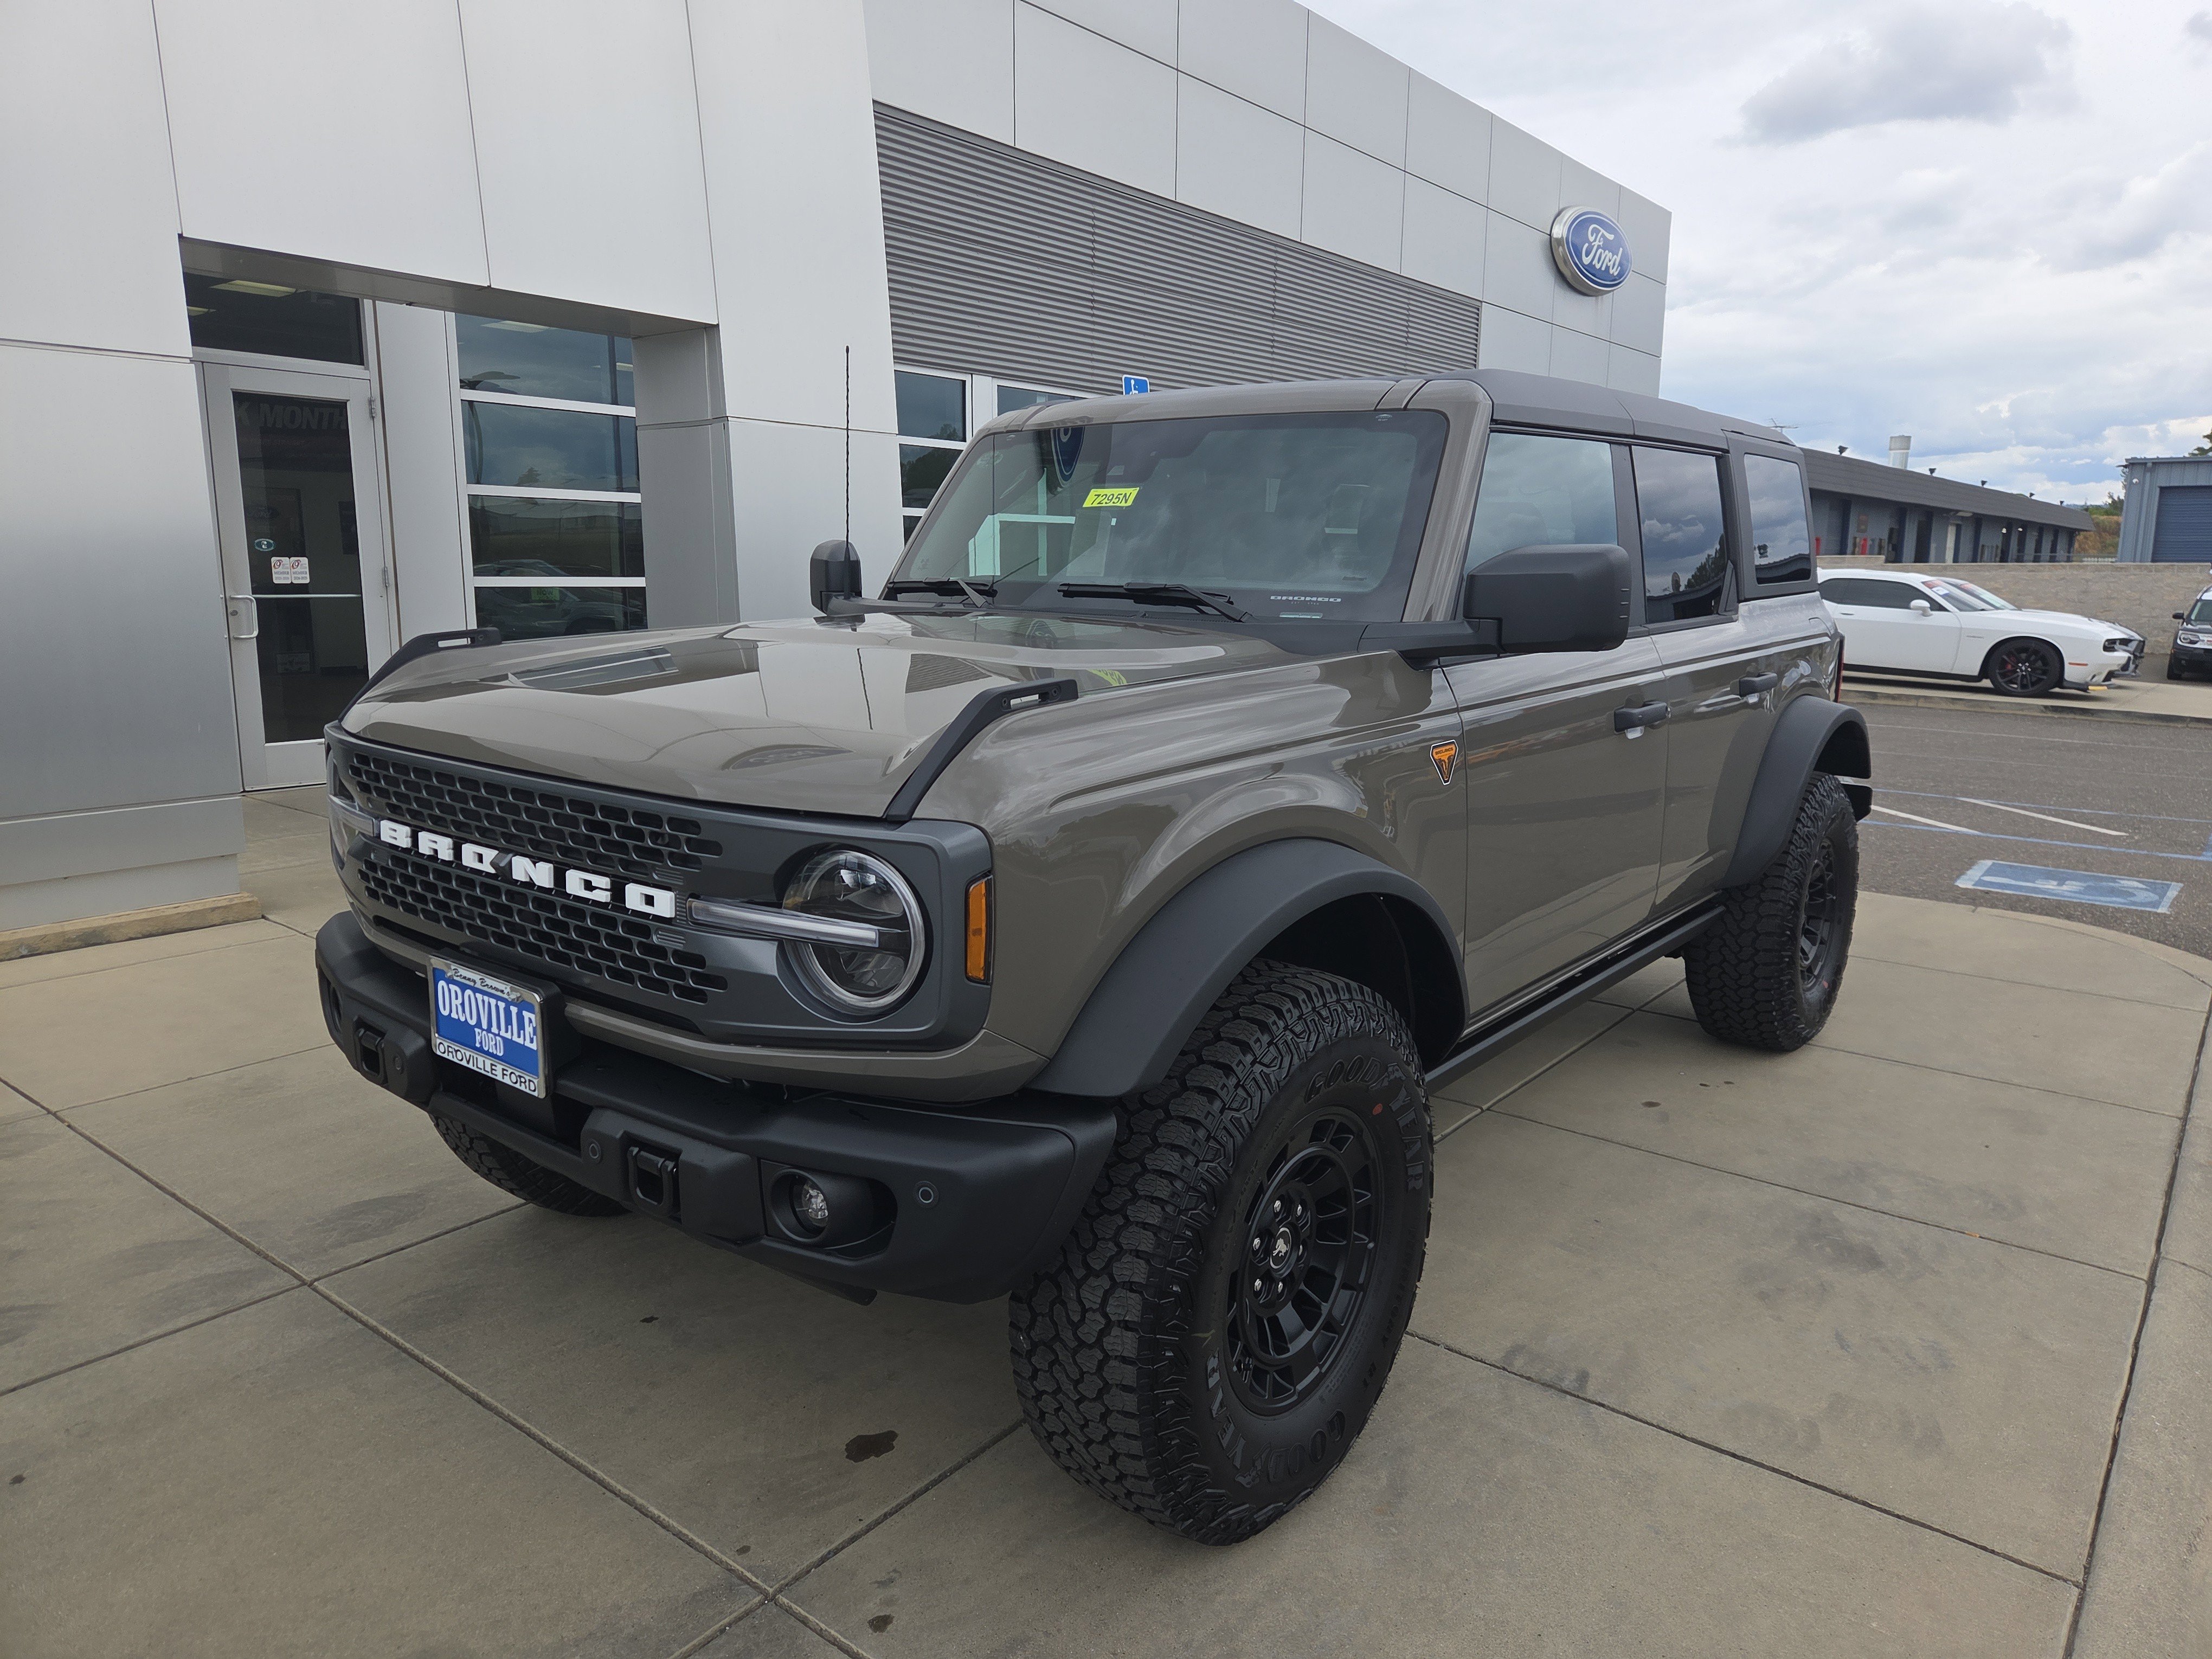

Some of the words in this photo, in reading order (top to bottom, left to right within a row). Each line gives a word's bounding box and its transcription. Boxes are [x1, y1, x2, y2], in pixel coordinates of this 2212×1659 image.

[1581, 224, 1623, 276] Ford
[259, 403, 347, 430] MONTH
[1090, 492, 1133, 505] 7295N
[380, 819, 676, 918] BRONCO
[438, 980, 537, 1051] OROVILLE
[438, 1041, 498, 1077] OROVILLE
[501, 1068, 537, 1092] FORD
[474, 1028, 504, 1057] FORD
